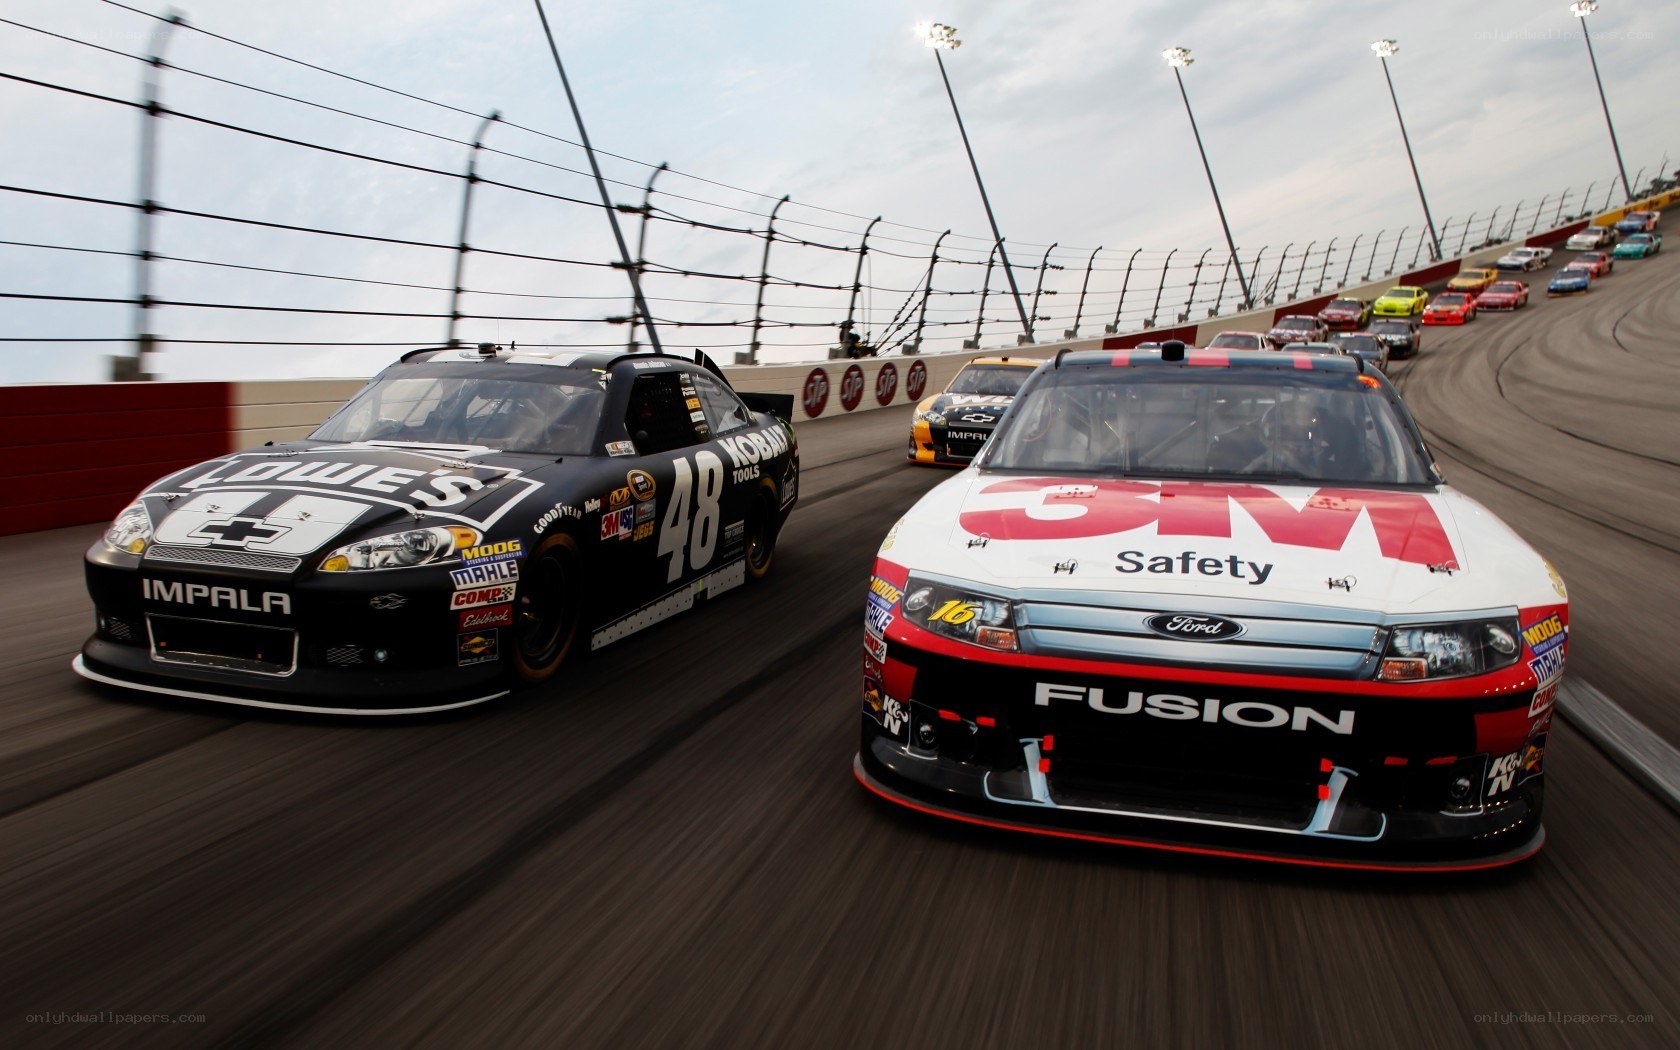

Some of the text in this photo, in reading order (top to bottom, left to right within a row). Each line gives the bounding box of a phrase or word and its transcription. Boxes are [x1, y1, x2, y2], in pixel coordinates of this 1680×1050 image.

[804, 375, 827, 408] STP
[841, 371, 862, 402] STP
[877, 369, 896, 397] STP
[908, 365, 926, 393] STP
[717, 425, 788, 468] KOBALT
[947, 431, 989, 441] IMPAL
[180, 459, 485, 507] LOWE'S
[733, 464, 760, 485] TOOLS
[533, 502, 582, 534] GOODYEAR
[602, 510, 620, 538] 3M
[657, 450, 724, 584] 48
[959, 476, 1460, 571] 3M
[461, 539, 522, 561] MOOG
[452, 560, 519, 586] MAHLE
[1115, 550, 1274, 585] Safety
[142, 578, 292, 615] IMPALA
[454, 587, 503, 607] COMP
[869, 577, 905, 605] MOOG
[463, 609, 509, 628] Edelbrock
[928, 600, 984, 625] 16
[1165, 615, 1226, 637] Ford
[1522, 614, 1563, 648] MOOG
[1532, 645, 1565, 684] MAHLE
[1033, 681, 1356, 735] FUSION
